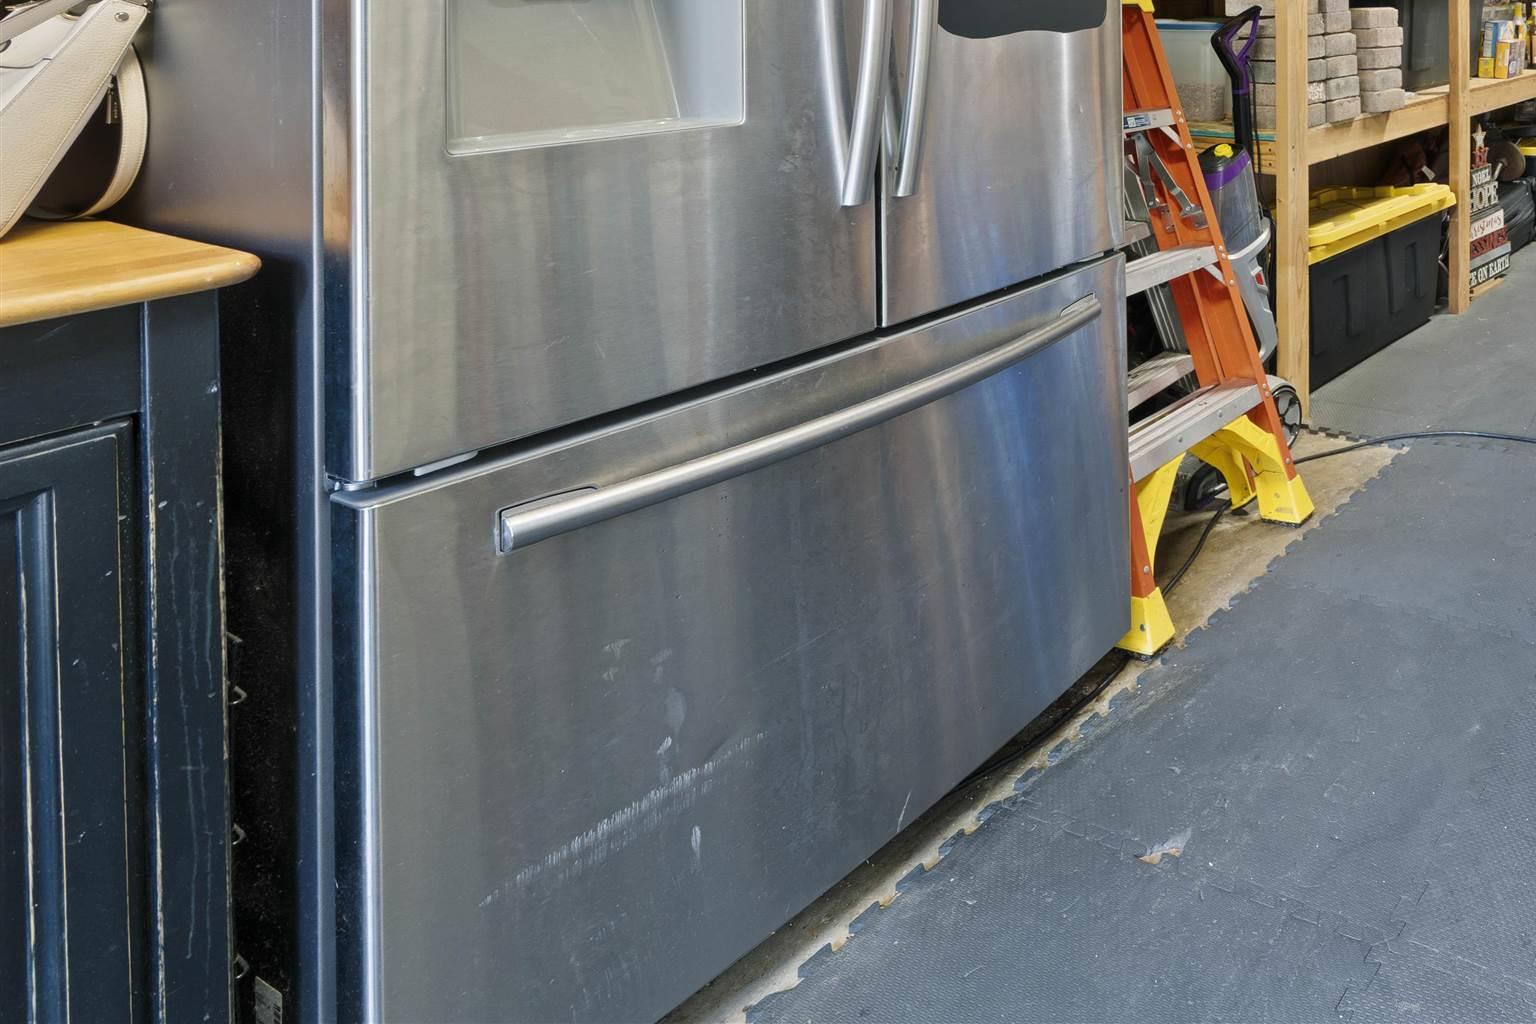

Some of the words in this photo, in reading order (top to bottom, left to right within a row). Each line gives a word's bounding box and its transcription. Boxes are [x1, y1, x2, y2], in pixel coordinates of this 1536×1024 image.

[1472, 164, 1491, 187] NOEL
[1478, 265, 1488, 283] ON
[1488, 254, 1510, 277] EARTH
